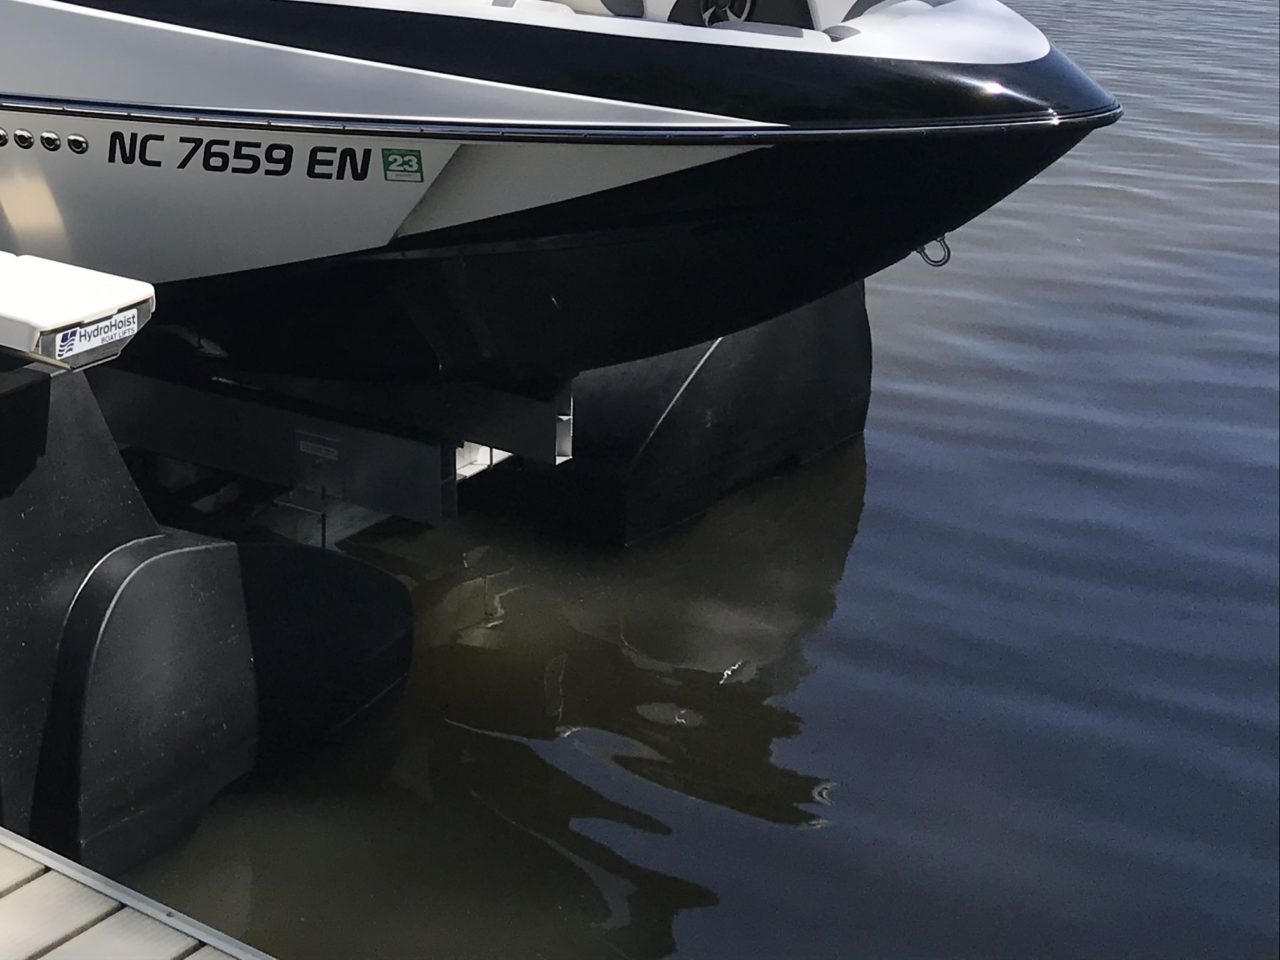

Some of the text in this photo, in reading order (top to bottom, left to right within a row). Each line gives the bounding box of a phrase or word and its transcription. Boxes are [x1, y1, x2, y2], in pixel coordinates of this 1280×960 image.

[108, 131, 372, 181] NC 7659 EN
[388, 155, 419, 171] 23
[79, 314, 136, 342] HydroHoist
[101, 327, 135, 344] BOAT LIFTS
